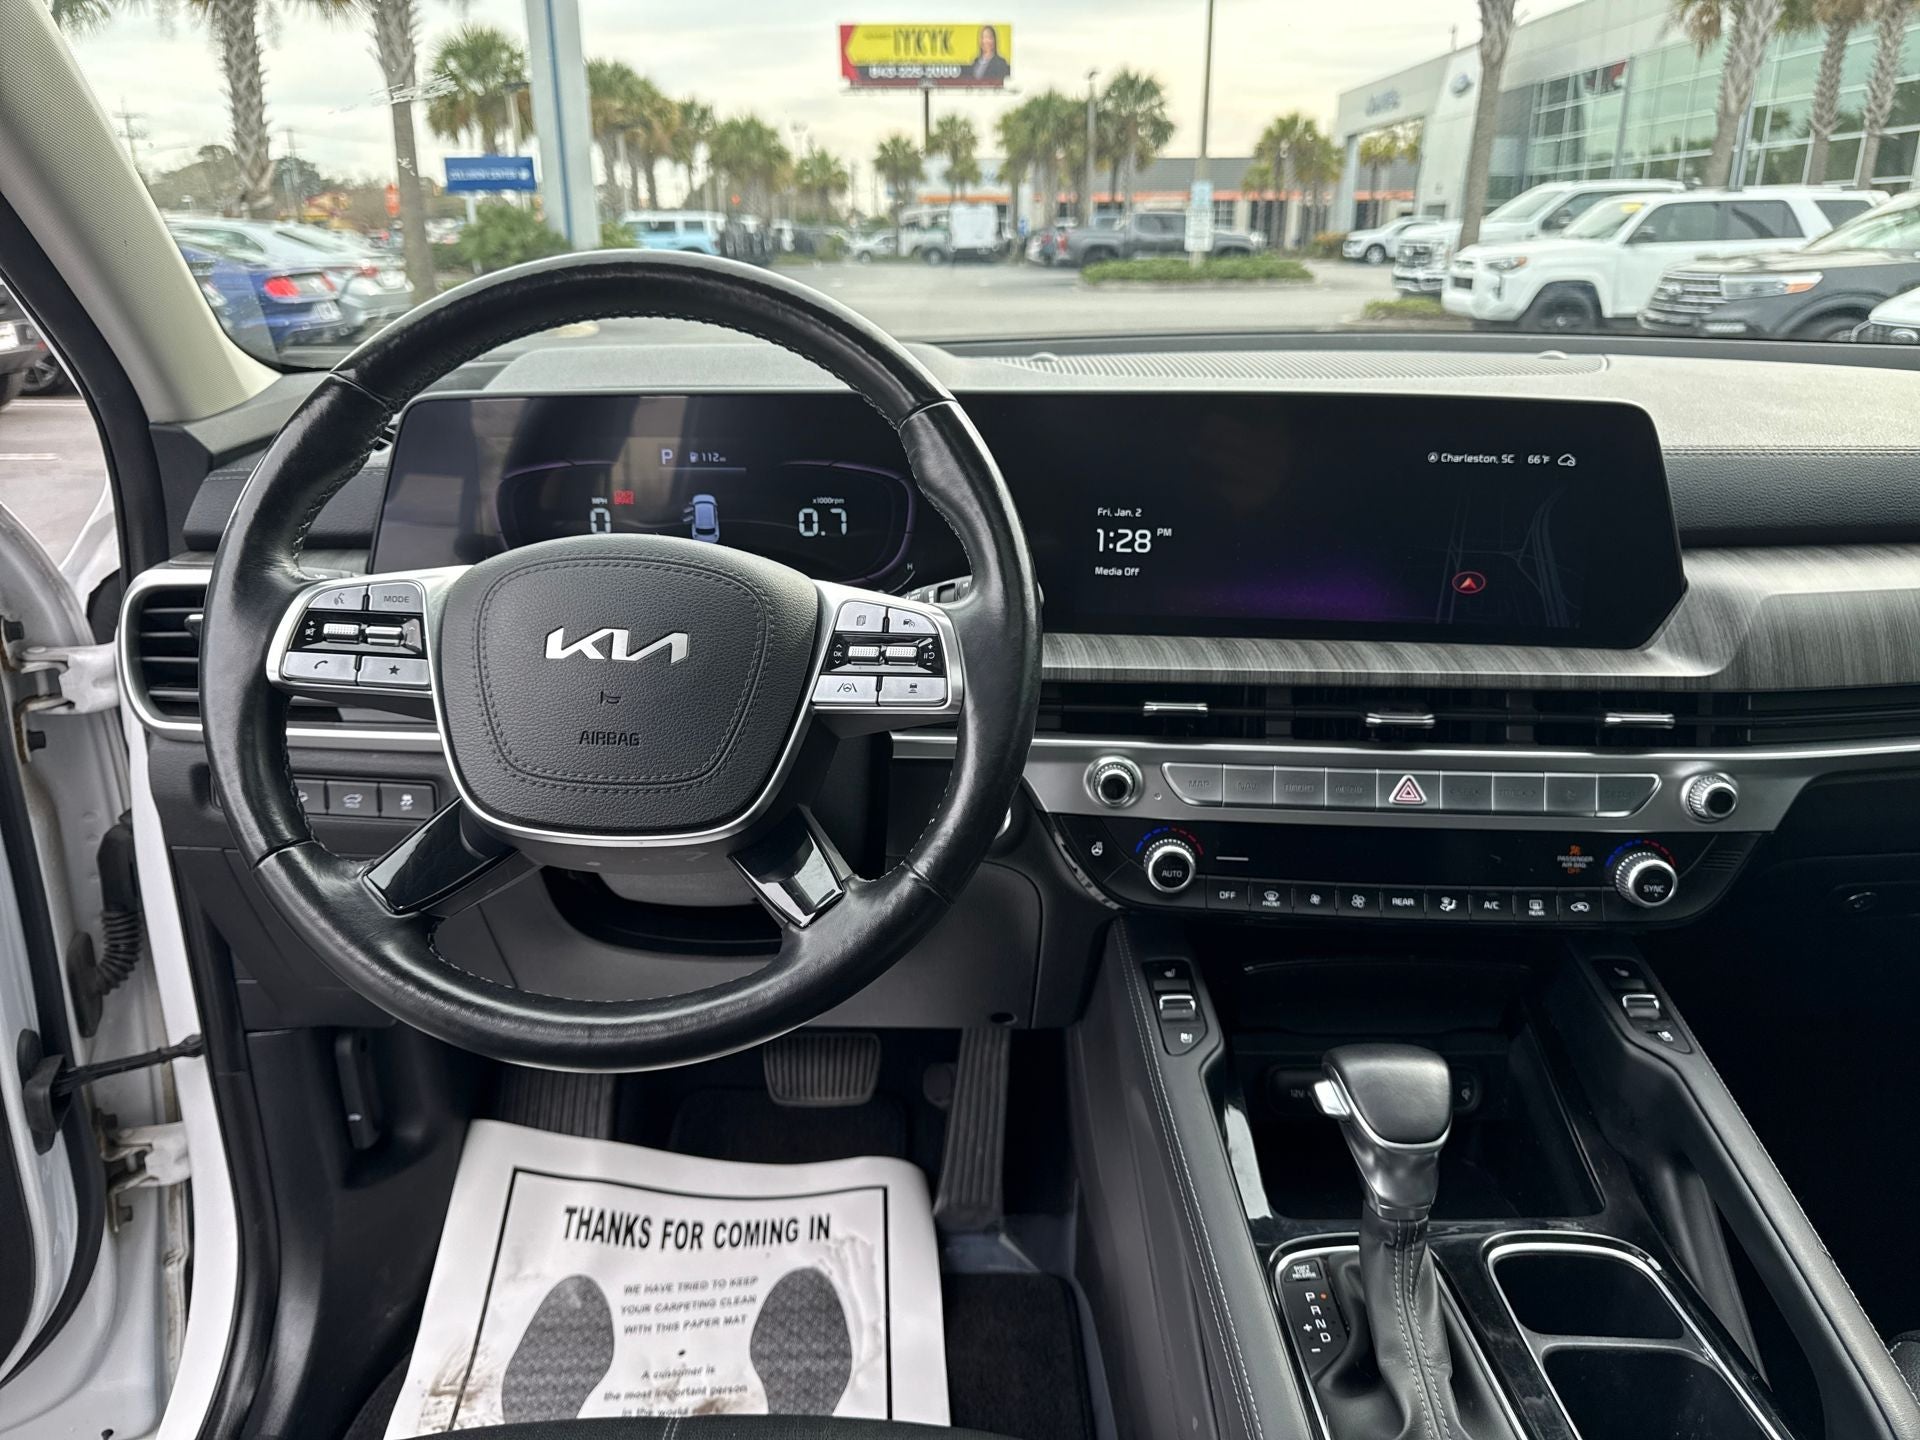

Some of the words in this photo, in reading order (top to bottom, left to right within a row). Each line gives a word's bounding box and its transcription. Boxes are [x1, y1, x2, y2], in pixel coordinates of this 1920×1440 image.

[661, 449, 673, 464] P
[1441, 453, 1498, 464] Charleston,
[1502, 454, 1515, 463] SC
[1135, 508, 1142, 517] 2
[590, 508, 611, 534] 0
[799, 508, 847, 536] 0.7
[1096, 528, 1151, 553] 1:28
[1157, 528, 1172, 536] PM
[1095, 566, 1122, 576] Media
[1124, 567, 1140, 576] Off
[384, 595, 410, 603] MODE
[544, 627, 689, 664] KIA
[579, 730, 640, 746] AIRBAG
[1162, 870, 1182, 878] AUTO
[1643, 884, 1664, 893] SYNC
[1219, 891, 1236, 900] OFF
[1262, 900, 1280, 908] FRONT
[1392, 898, 1414, 906] REAR
[1484, 901, 1500, 910] A/C
[564, 1206, 652, 1249] THANKS
[660, 1218, 703, 1251] FOR
[713, 1218, 799, 1249] COMING
[809, 1213, 831, 1241] IN
[623, 1284, 641, 1295] WE
[643, 1283, 673, 1293] HAVE
[678, 1280, 710, 1292] TRIED
[713, 1278, 727, 1289] TO
[729, 1275, 759, 1288] KEEP
[1305, 1292, 1315, 1302] P
[621, 1303, 651, 1315] YOUR
[654, 1298, 718, 1313] CARPETING
[720, 1295, 757, 1307] CLEAN
[1311, 1305, 1321, 1315] R
[623, 1324, 652, 1335] WITH
[656, 1321, 680, 1332] THIS
[682, 1317, 721, 1330] PAPER
[723, 1314, 746, 1326] MAT
[1315, 1319, 1327, 1329] N
[1320, 1332, 1331, 1343] D
[640, 1370, 649, 1380] A
[653, 1366, 702, 1379] customer
[604, 1391, 621, 1401] the
[624, 1390, 651, 1400] most
[655, 1386, 707, 1400] important
[710, 1384, 748, 1396] person
[636, 1407, 653, 1416] the
